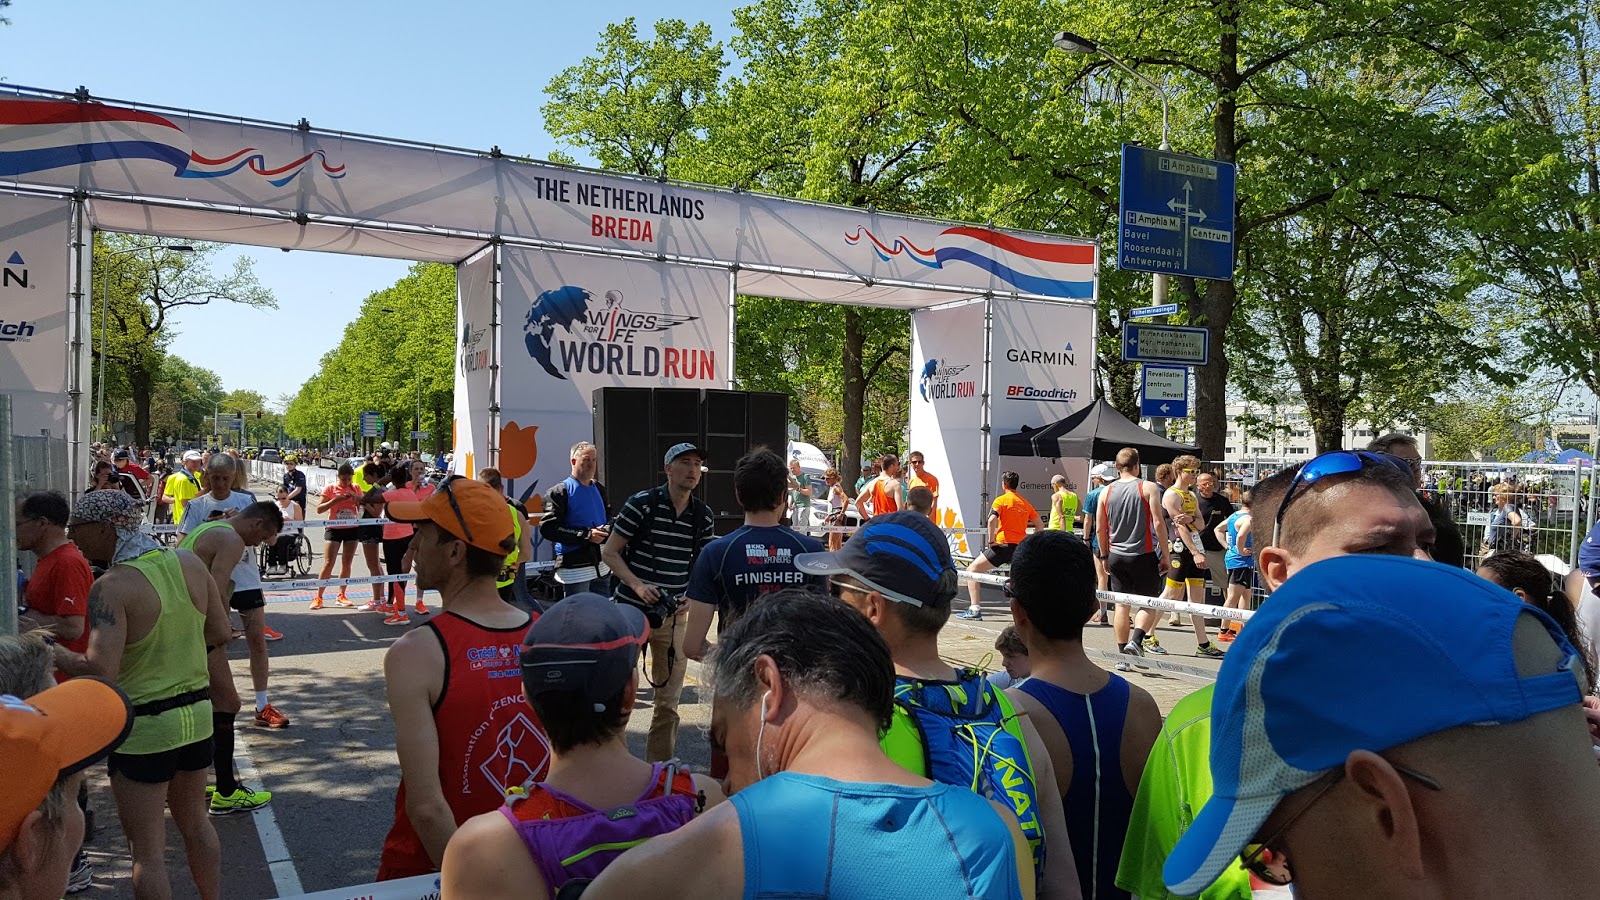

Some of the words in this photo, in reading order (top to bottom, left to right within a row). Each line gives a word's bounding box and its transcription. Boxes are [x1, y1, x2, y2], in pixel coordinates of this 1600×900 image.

[1171, 161, 1204, 174] Amphia
[534, 177, 570, 204] THE
[577, 183, 705, 221] NETHERLANDS
[1138, 214, 1168, 227] Amphia
[591, 214, 653, 243] BREDA
[1124, 229, 1150, 240] Bavel
[1192, 228, 1229, 241] Centrum
[1124, 242, 1175, 256] Roosendaal
[1123, 255, 1172, 269] Antwerpen
[583, 326, 599, 334] FOR
[1006, 348, 1075, 366] GARMIN
[1006, 385, 1077, 399] BFGoodrich
[1162, 391, 1184, 399] Revant
[1020, 482, 1052, 490] Gemeent
[735, 571, 804, 585] FINISHER
[462, 721, 490, 794] Association
